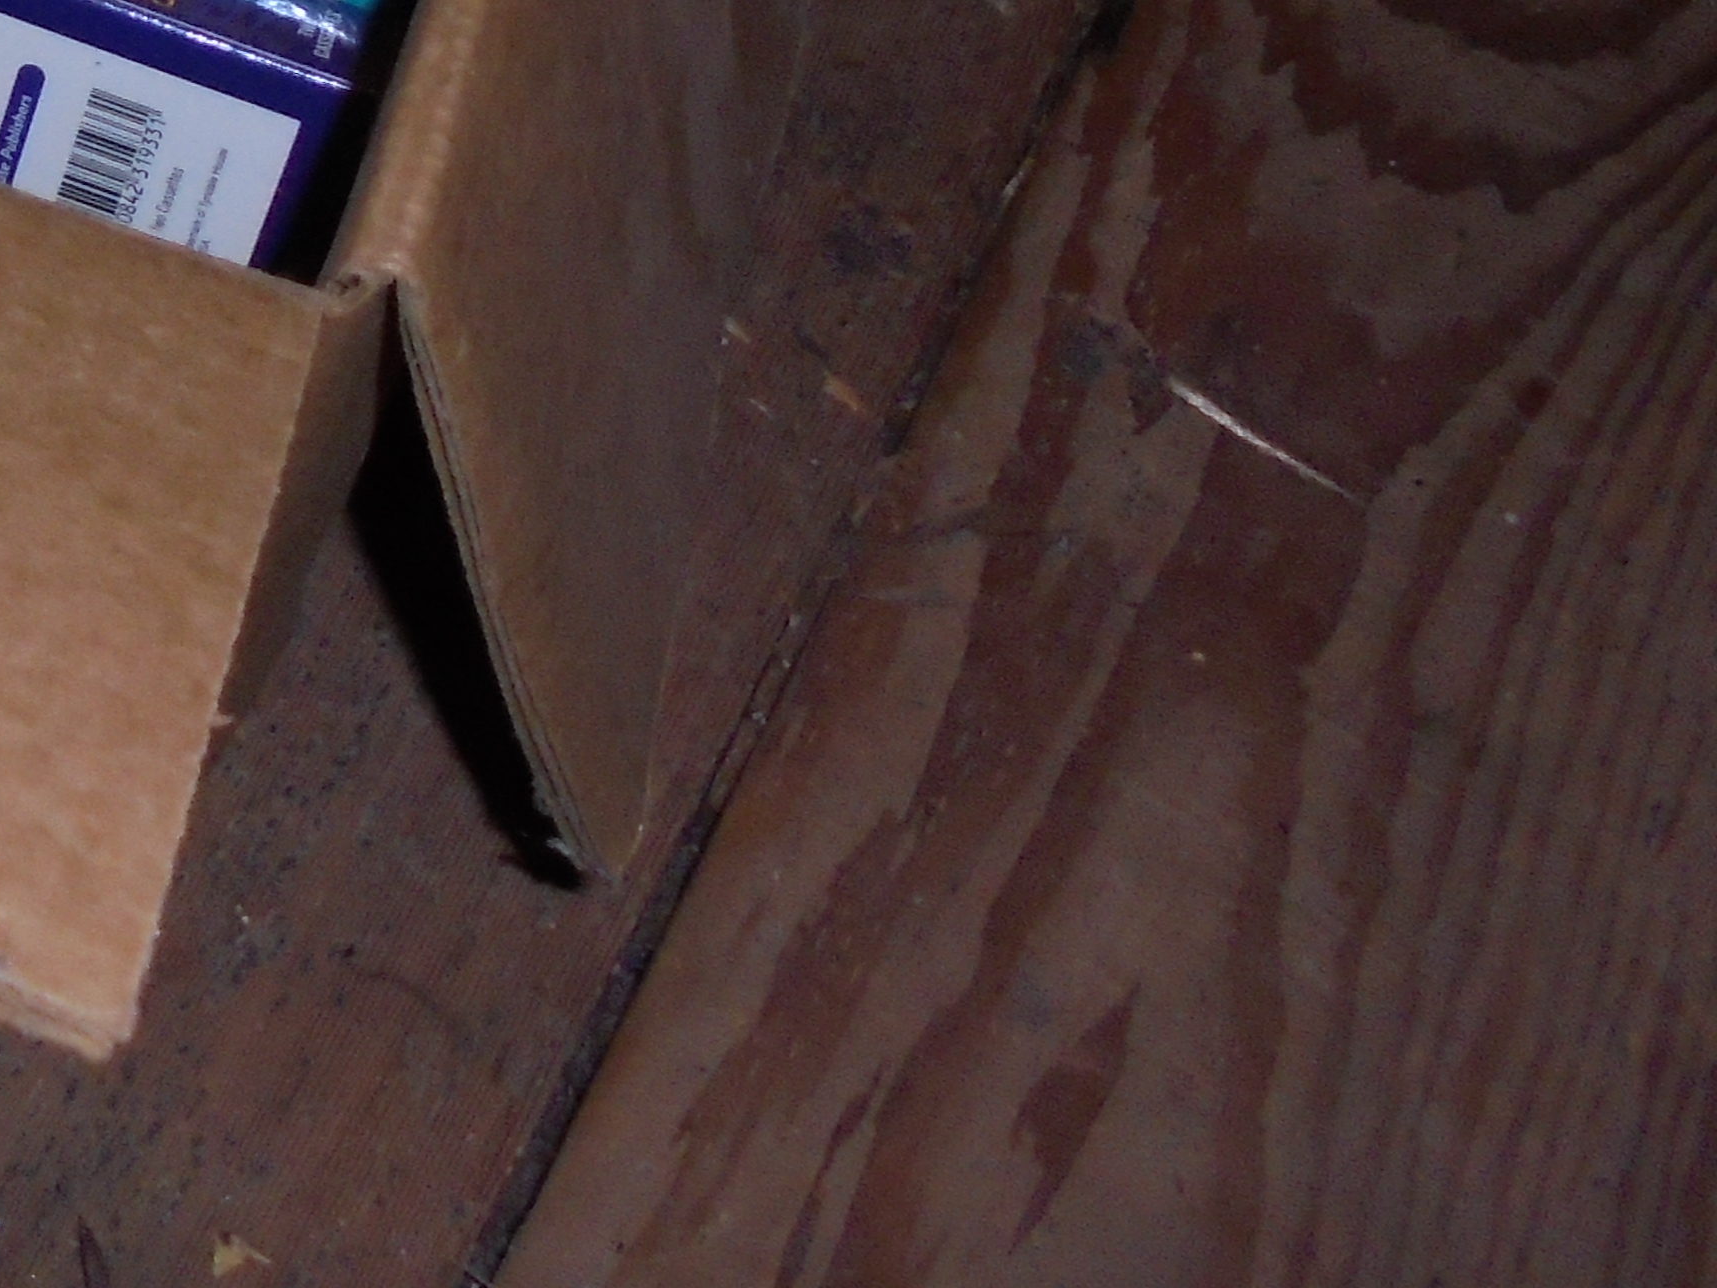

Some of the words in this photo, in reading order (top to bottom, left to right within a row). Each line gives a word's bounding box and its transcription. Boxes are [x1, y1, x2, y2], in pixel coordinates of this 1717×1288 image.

[1, 91, 32, 161] Publishers
[131, 114, 166, 180] 319331
[155, 163, 184, 215] Cassettes
